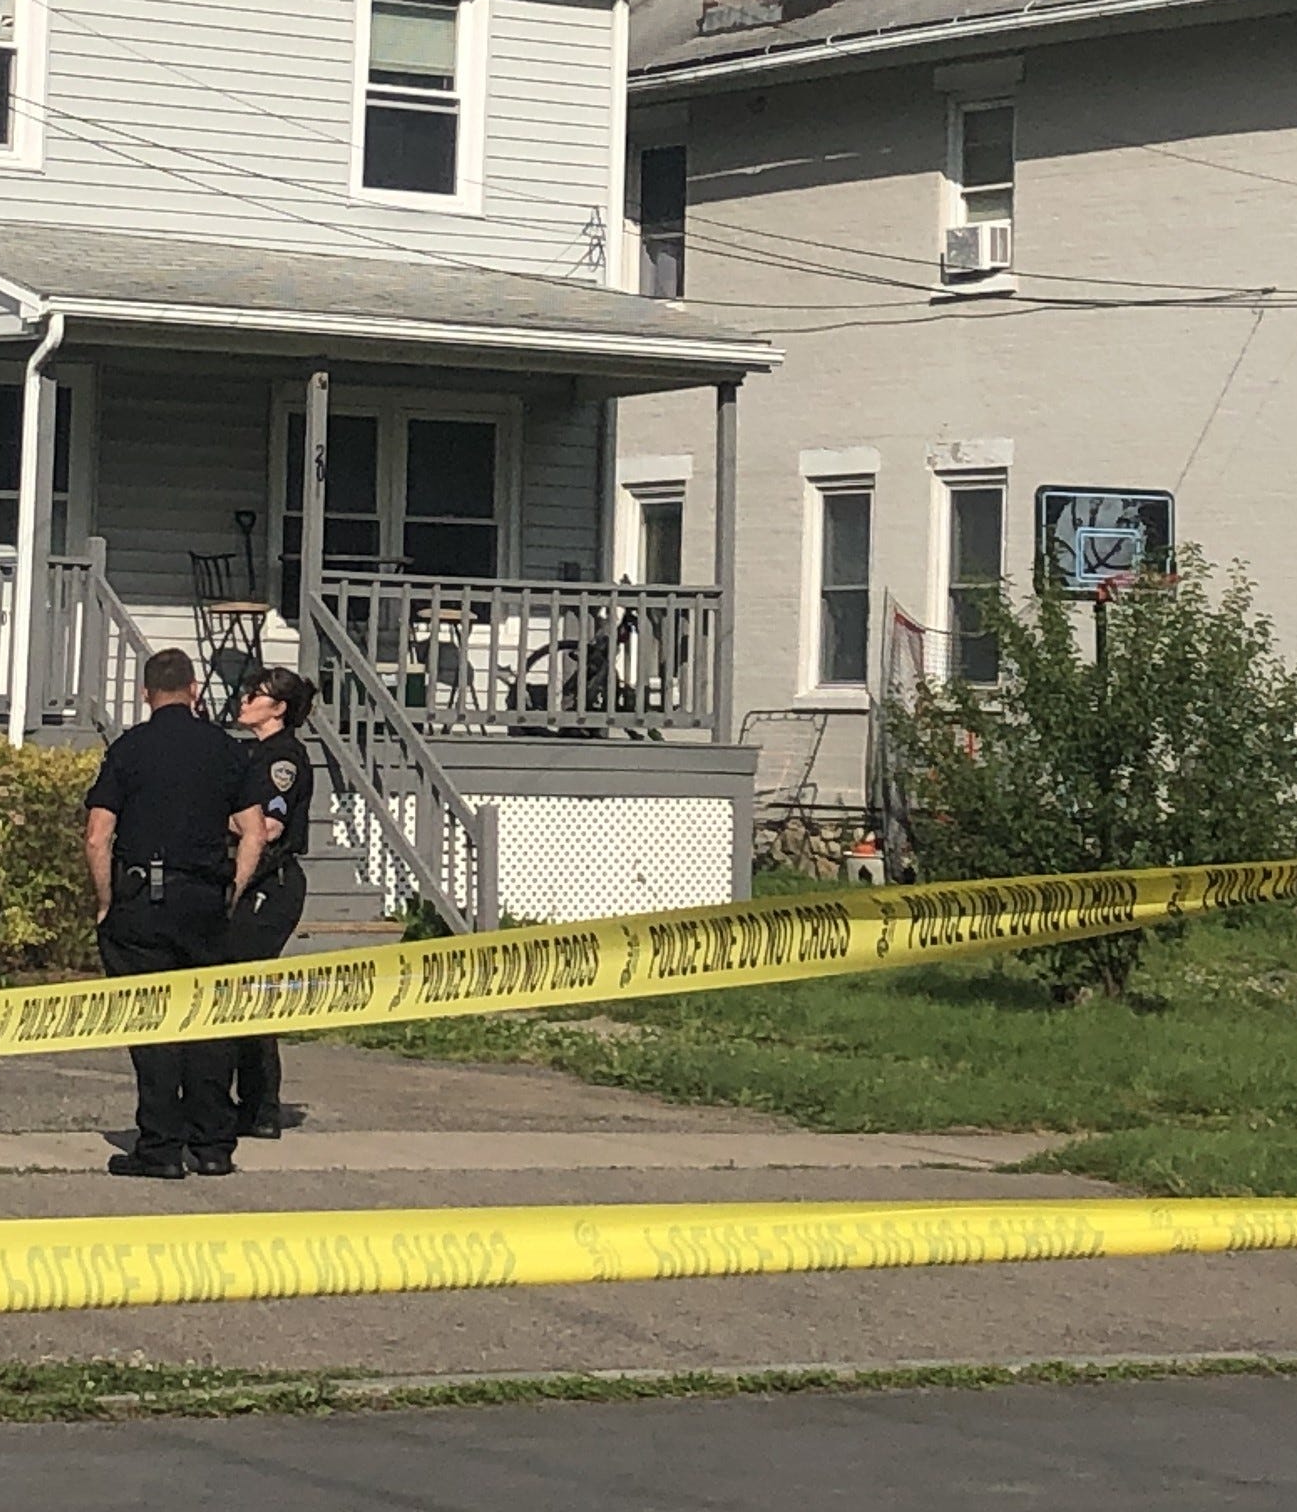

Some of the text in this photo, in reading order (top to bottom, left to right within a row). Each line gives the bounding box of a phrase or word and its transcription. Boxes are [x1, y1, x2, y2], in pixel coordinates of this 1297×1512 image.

[647, 920, 702, 979] POLICE
[699, 915, 737, 973] LINE
[736, 912, 761, 968] DO
[760, 909, 793, 966] NOT
[795, 901, 851, 962] CROSS
[901, 890, 966, 948] POLICE
[415, 950, 466, 1004] POLICE
[464, 945, 497, 998] LINE
[497, 942, 522, 995] DO
[518, 939, 550, 993] NOT
